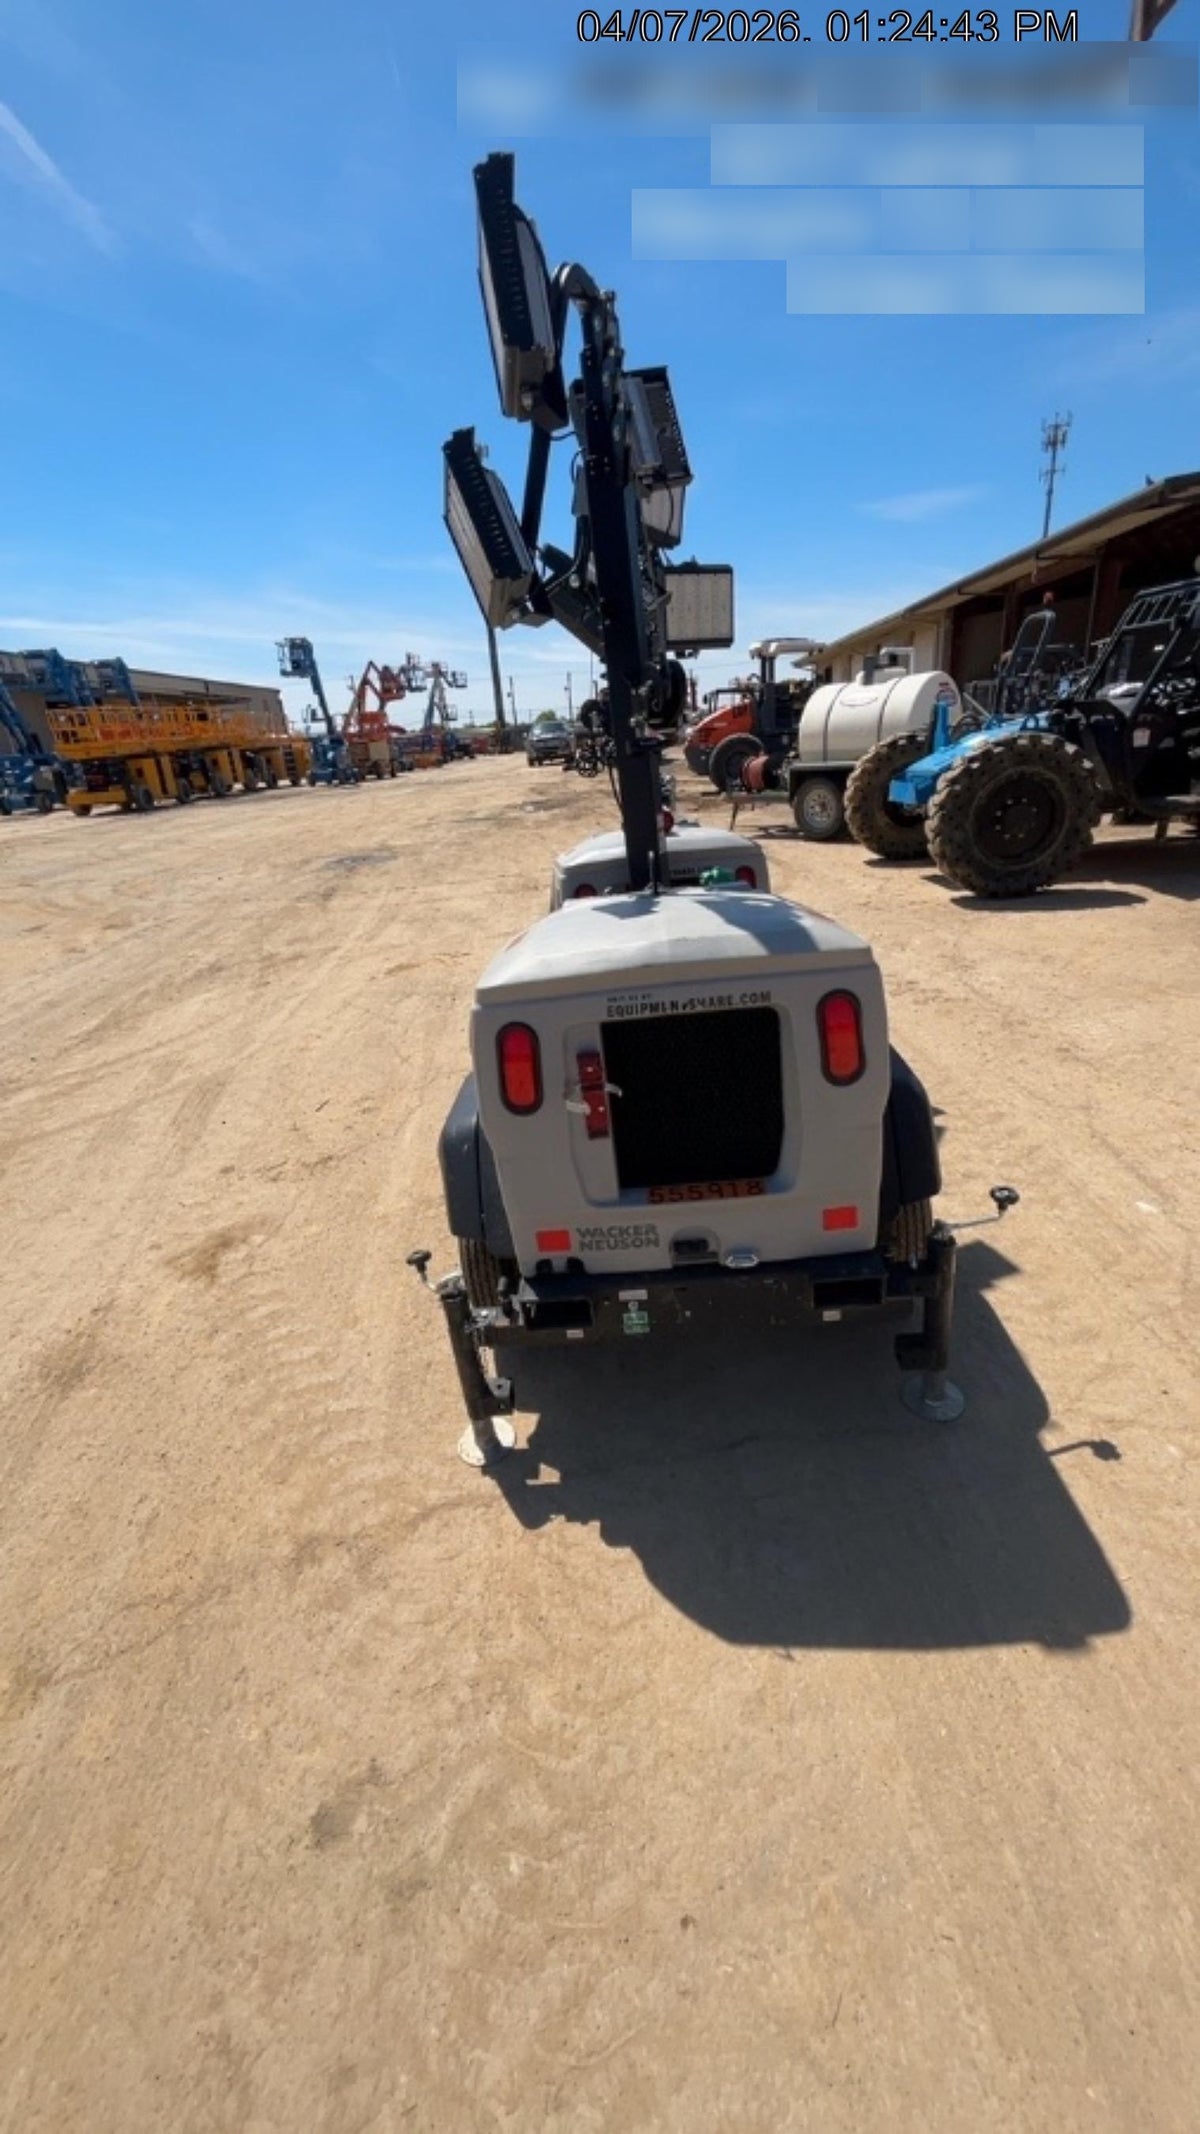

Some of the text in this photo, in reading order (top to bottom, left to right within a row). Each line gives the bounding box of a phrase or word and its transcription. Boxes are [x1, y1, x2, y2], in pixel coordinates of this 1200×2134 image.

[649, 1180, 763, 1203] 555918
[576, 1223, 659, 1238] WACKER
[578, 1236, 660, 1252] NEUSON
